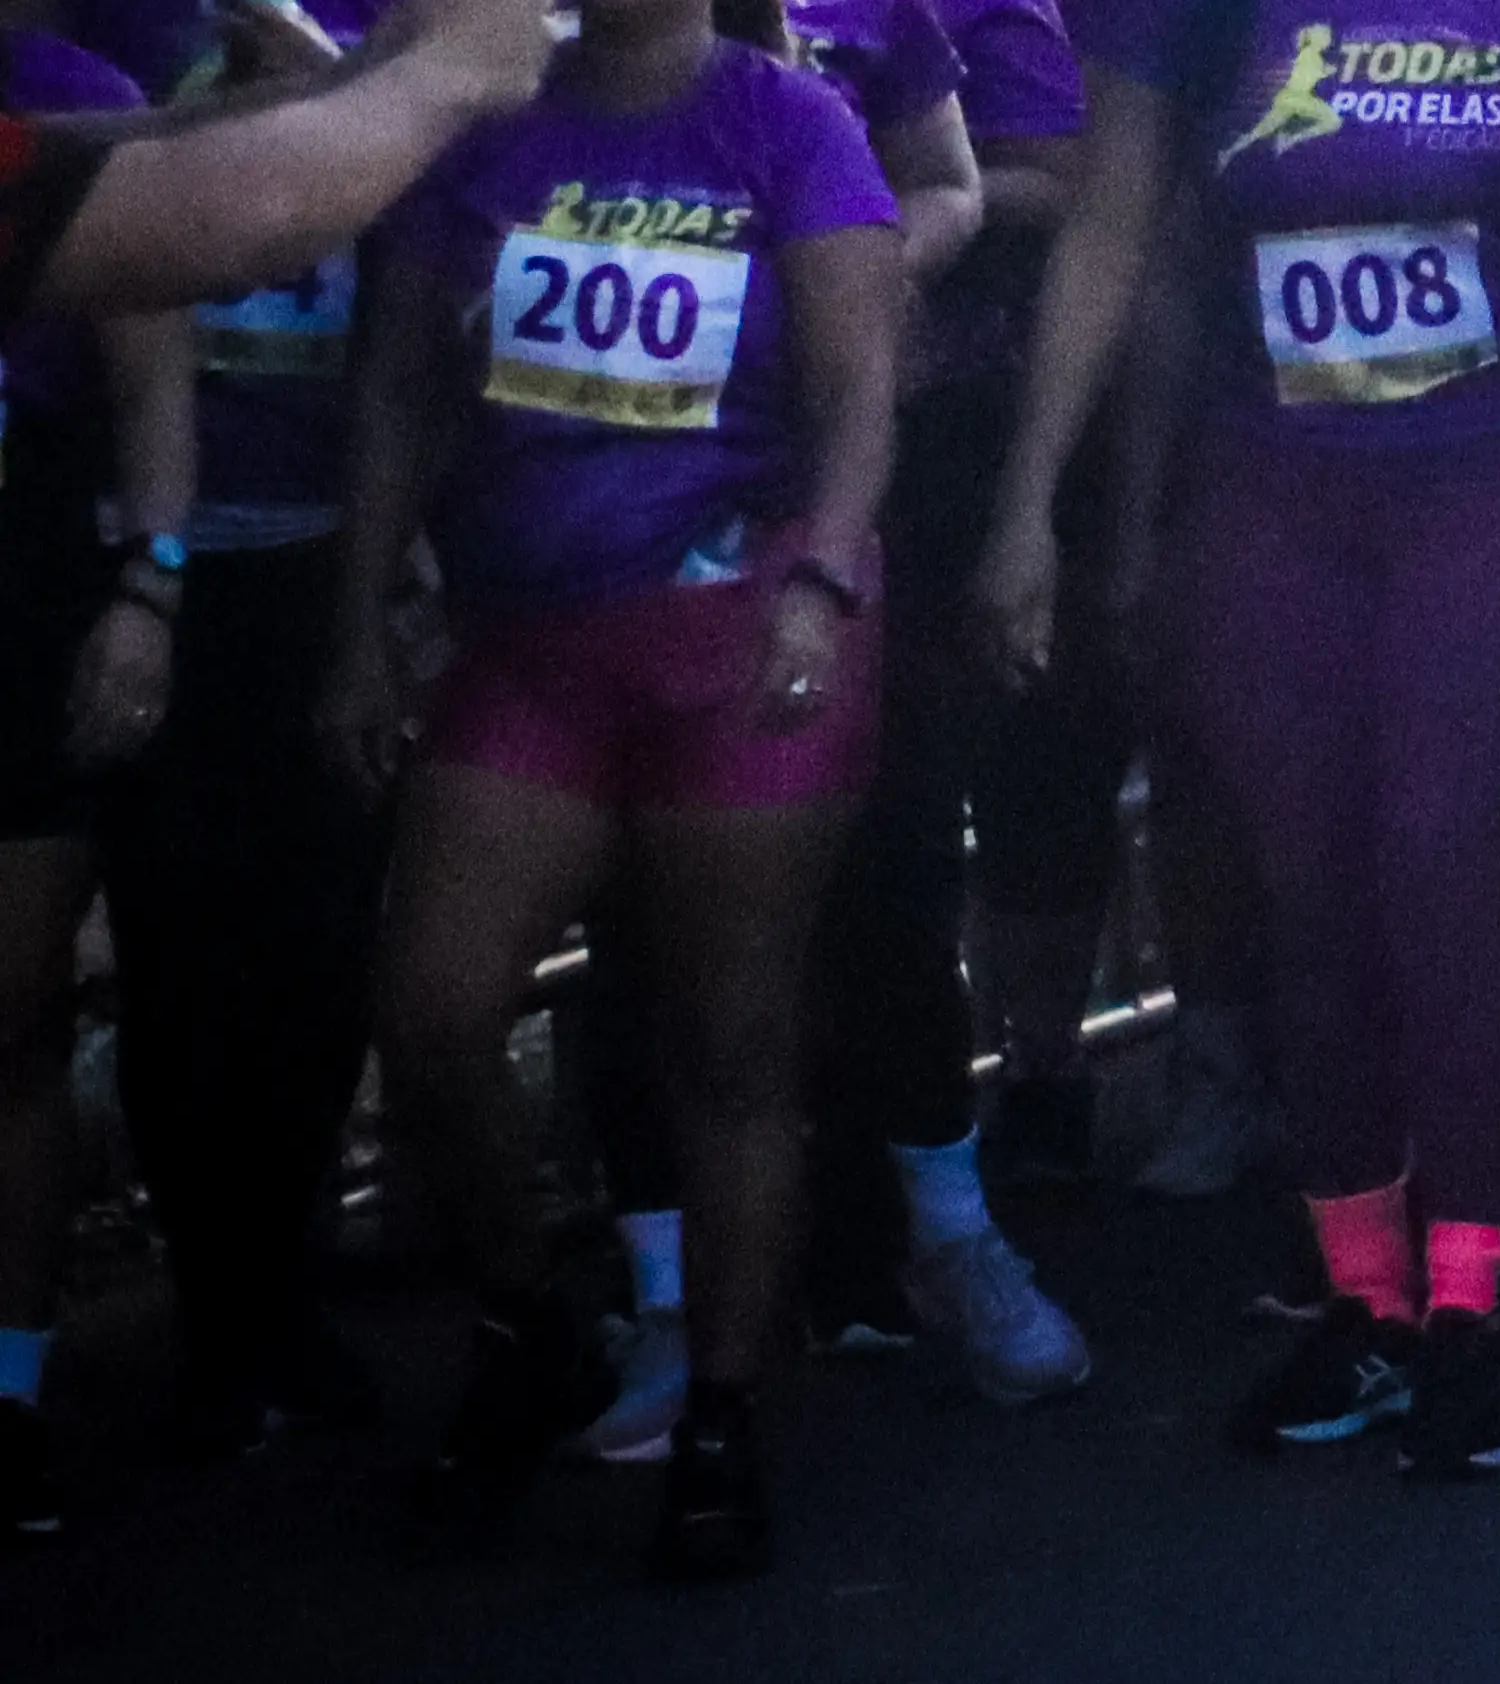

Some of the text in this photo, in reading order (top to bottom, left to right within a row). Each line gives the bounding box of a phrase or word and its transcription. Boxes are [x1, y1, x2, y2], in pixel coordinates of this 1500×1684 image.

[1331, 90, 1412, 124] POR
[588, 196, 753, 241] TODAS
[514, 255, 699, 360] 200
[1281, 247, 1460, 343] 008
